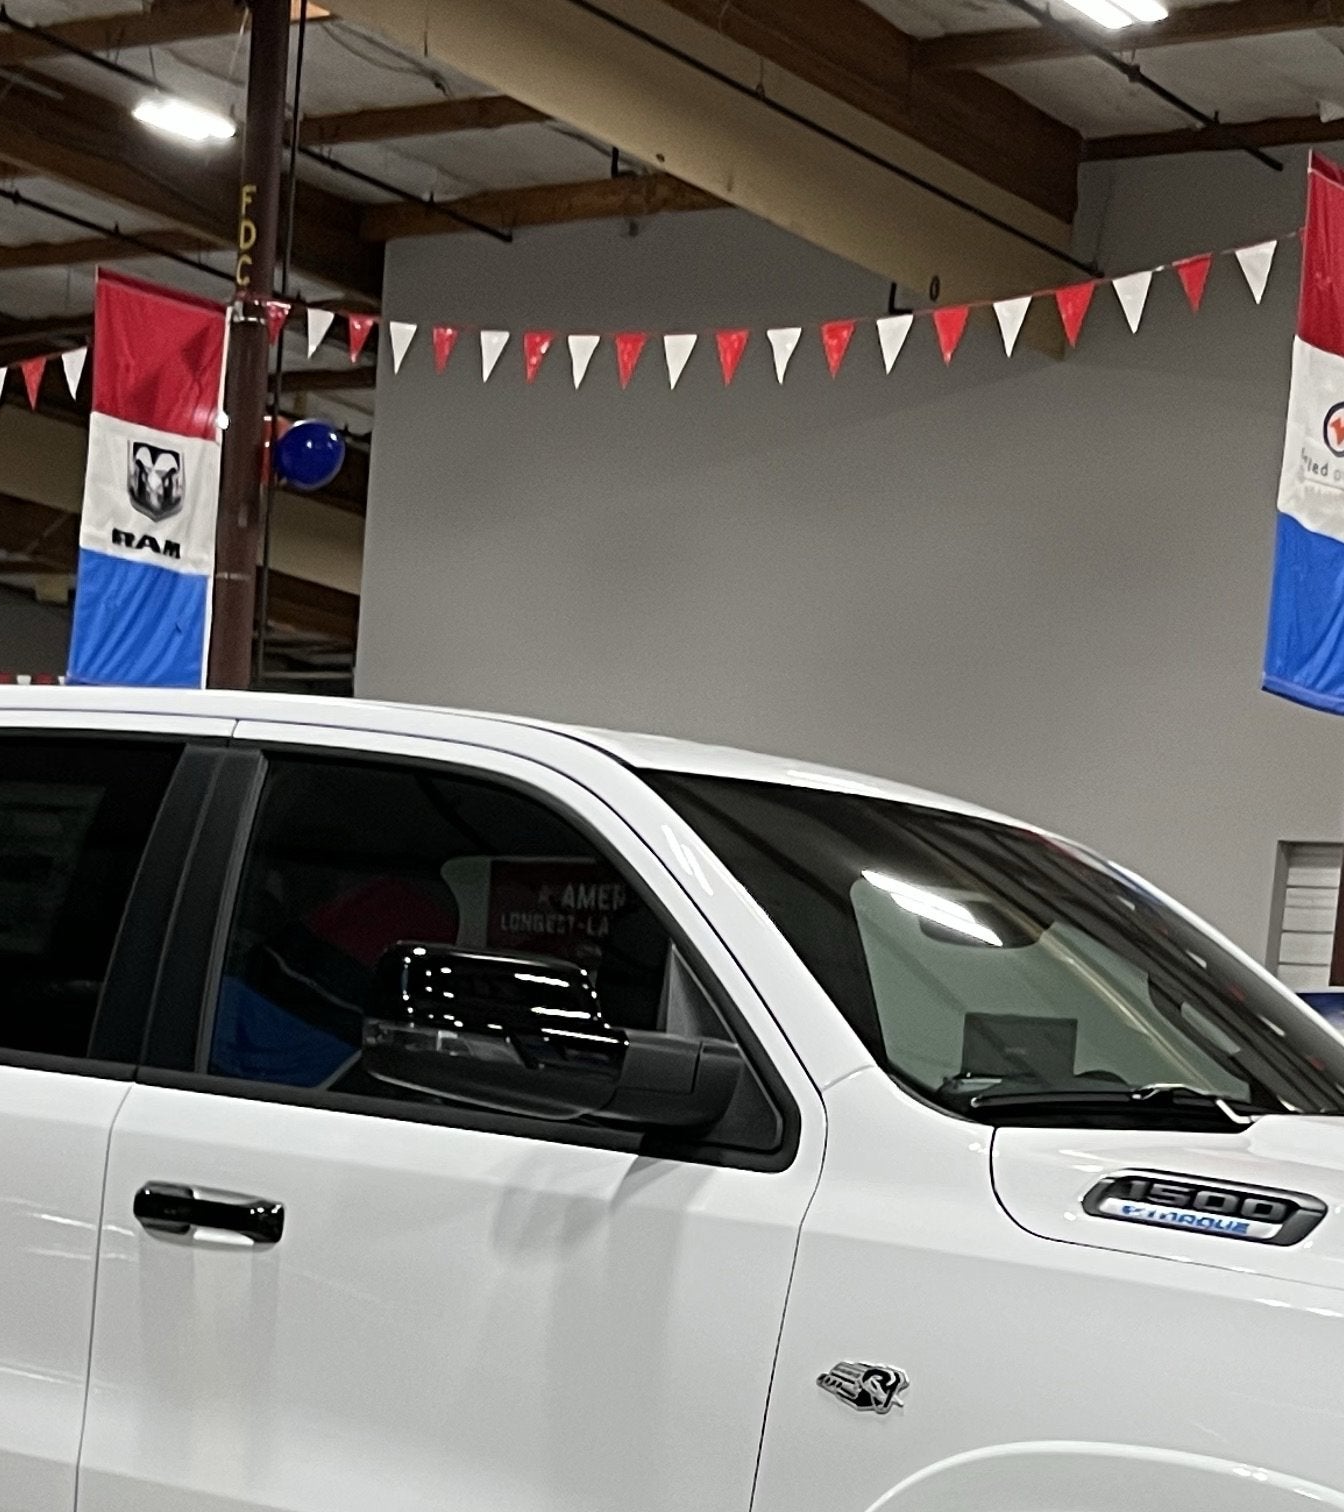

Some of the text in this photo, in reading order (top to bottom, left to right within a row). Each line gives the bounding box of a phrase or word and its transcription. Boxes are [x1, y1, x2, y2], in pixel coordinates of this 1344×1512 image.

[236, 184, 257, 286] FDC
[111, 528, 181, 559] RAM
[1126, 1179, 1288, 1220] 1500
